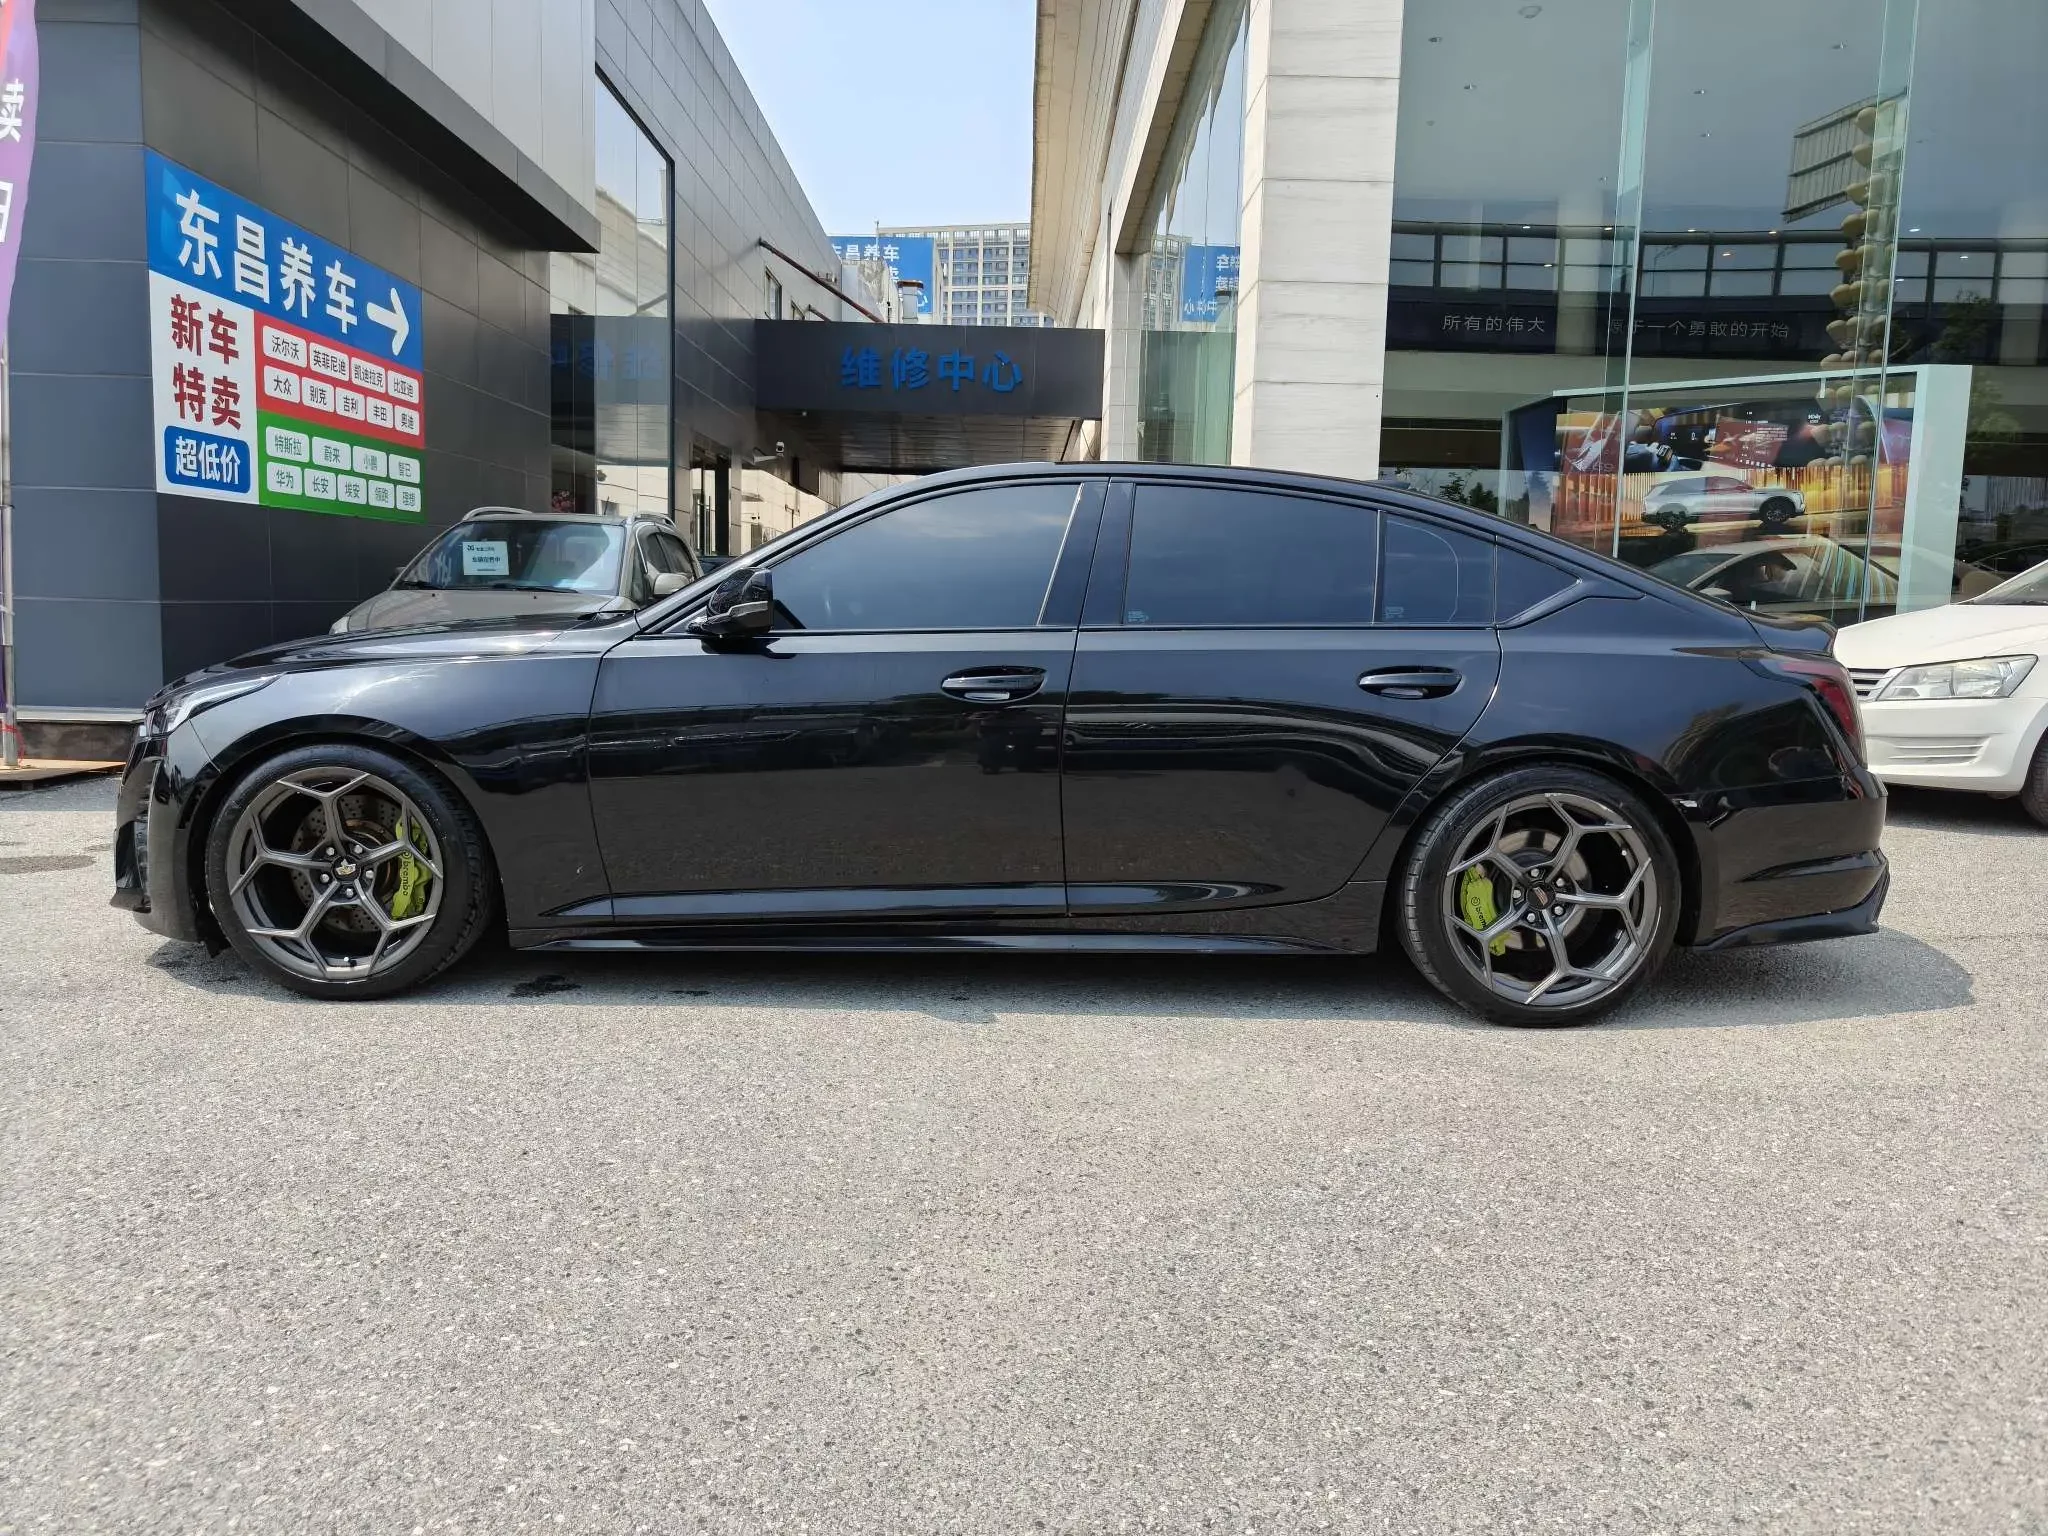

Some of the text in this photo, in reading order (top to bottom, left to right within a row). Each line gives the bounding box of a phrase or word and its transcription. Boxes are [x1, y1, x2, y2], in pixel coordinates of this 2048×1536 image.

[175, 188, 359, 335] 东昌养车
[170, 292, 241, 367] 新车
[1441, 314, 1546, 333] 所有的伟大
[271, 335, 414, 398] 沃尔沃 英菲尼迪 凯迪拉克 比亚迪
[840, 346, 1024, 393] 维修中心
[172, 361, 242, 431] 特卖
[273, 374, 292, 397] 大众
[309, 385, 328, 406] 别克
[343, 394, 359, 415] 吉利
[373, 404, 387, 422] 丰田
[174, 434, 242, 486] 超低价
[274, 434, 302, 456] 特斯拉
[323, 444, 341, 464] 蔚来
[275, 468, 294, 489] 华为
[312, 475, 329, 495] 长安
[344, 481, 361, 499] 埃安
[402, 860, 412, 897] brembo
